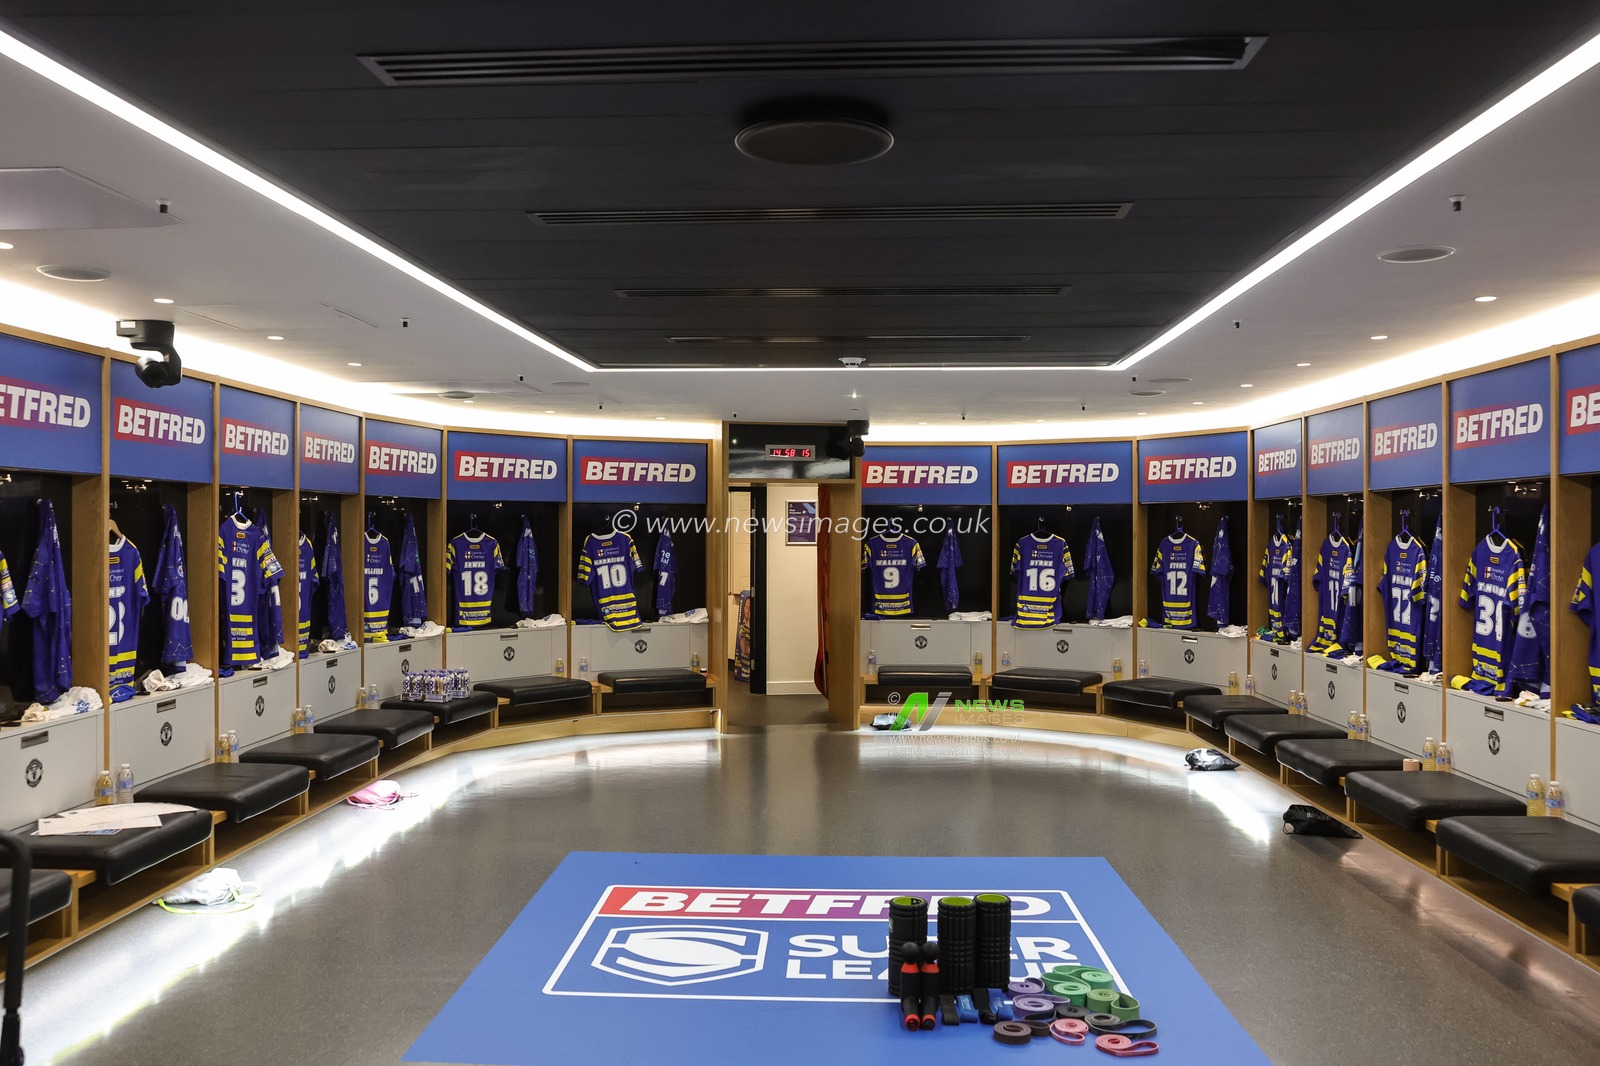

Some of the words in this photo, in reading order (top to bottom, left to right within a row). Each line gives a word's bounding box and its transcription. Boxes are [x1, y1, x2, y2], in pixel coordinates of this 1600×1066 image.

[118, 405, 206, 445] BETFRED
[1456, 403, 1543, 443] BETFRED
[225, 423, 289, 456] BETFRED
[305, 436, 355, 463] BETFRED
[1310, 437, 1360, 465] BETFRED
[1374, 422, 1438, 456] BETFRED
[368, 446, 437, 474] BETFRED
[784, 448, 796, 457] 58
[801, 449, 810, 457] 15
[1258, 448, 1297, 472] BETFRED
[459, 455, 557, 480] BETFRED
[585, 461, 696, 482] BETFRED
[866, 465, 978, 484] BETFRED
[1011, 463, 1119, 484] BETFRED
[1147, 456, 1237, 480] BETFRED
[232, 557, 247, 568] KIN
[593, 556, 625, 566] HARRISON
[1029, 559, 1054, 567] BYRNE
[230, 569, 246, 606] 3
[461, 570, 488, 596] 18
[596, 563, 627, 589] 10
[883, 567, 900, 588] 9
[1026, 568, 1056, 592] 16
[1166, 570, 1188, 596] 12
[368, 577, 379, 606] 6
[619, 890, 1052, 917] BETFD
[788, 934, 1079, 961] SUR
